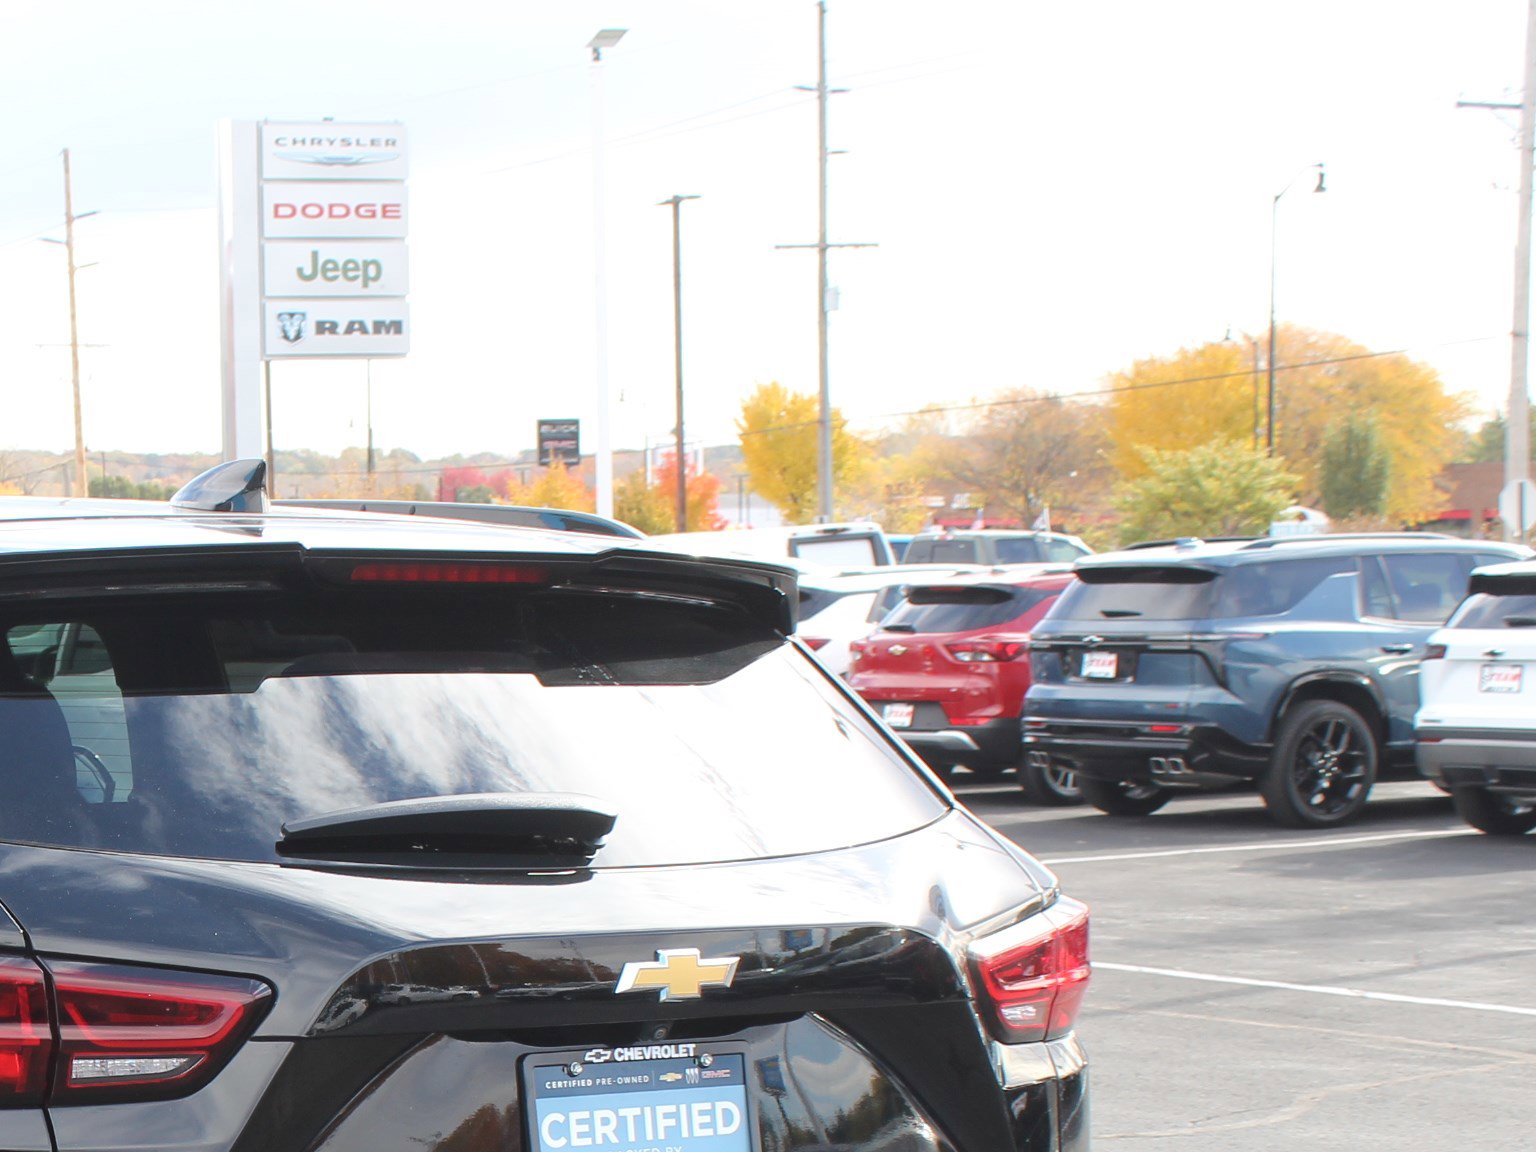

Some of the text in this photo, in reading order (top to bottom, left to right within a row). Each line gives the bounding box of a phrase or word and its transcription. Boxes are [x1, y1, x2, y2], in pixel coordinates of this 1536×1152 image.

[275, 137, 397, 147] CHRYSLER
[273, 203, 402, 219] DODGE
[296, 250, 382, 288] Jeep
[315, 320, 403, 335] RAM
[614, 1044, 697, 1062] CHEVROLET
[545, 1075, 650, 1089] CERTIFIED PRE-OWNED
[541, 1101, 741, 1149] CERTIFIED
